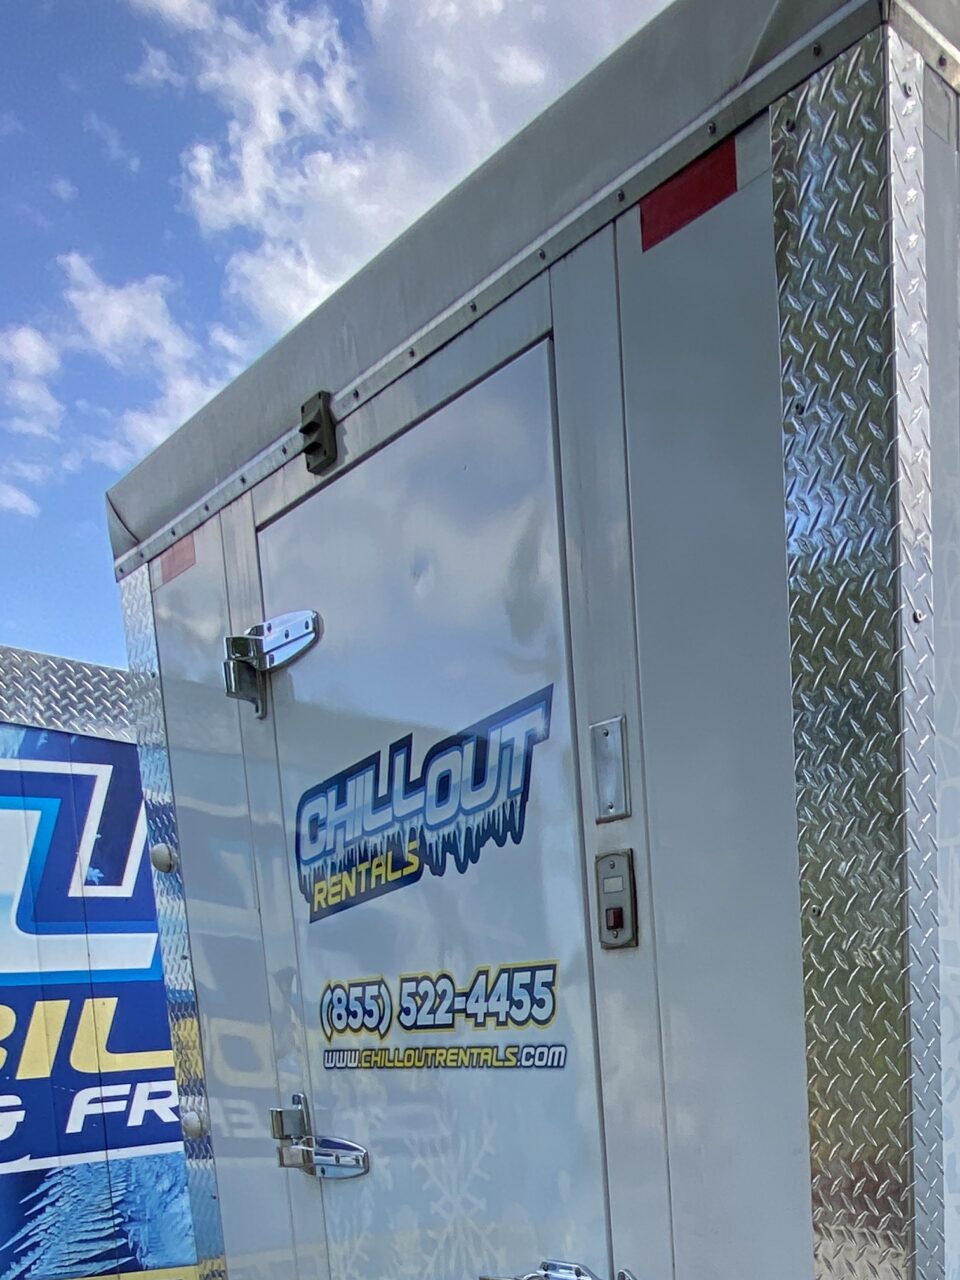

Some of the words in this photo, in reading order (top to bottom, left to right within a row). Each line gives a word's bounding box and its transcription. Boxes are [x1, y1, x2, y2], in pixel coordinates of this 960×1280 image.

[314, 840, 419, 912] RENTALS
[0, 997, 176, 1080] IL
[320, 976, 393, 1041] (855)
[398, 965, 558, 1030] 522-4455
